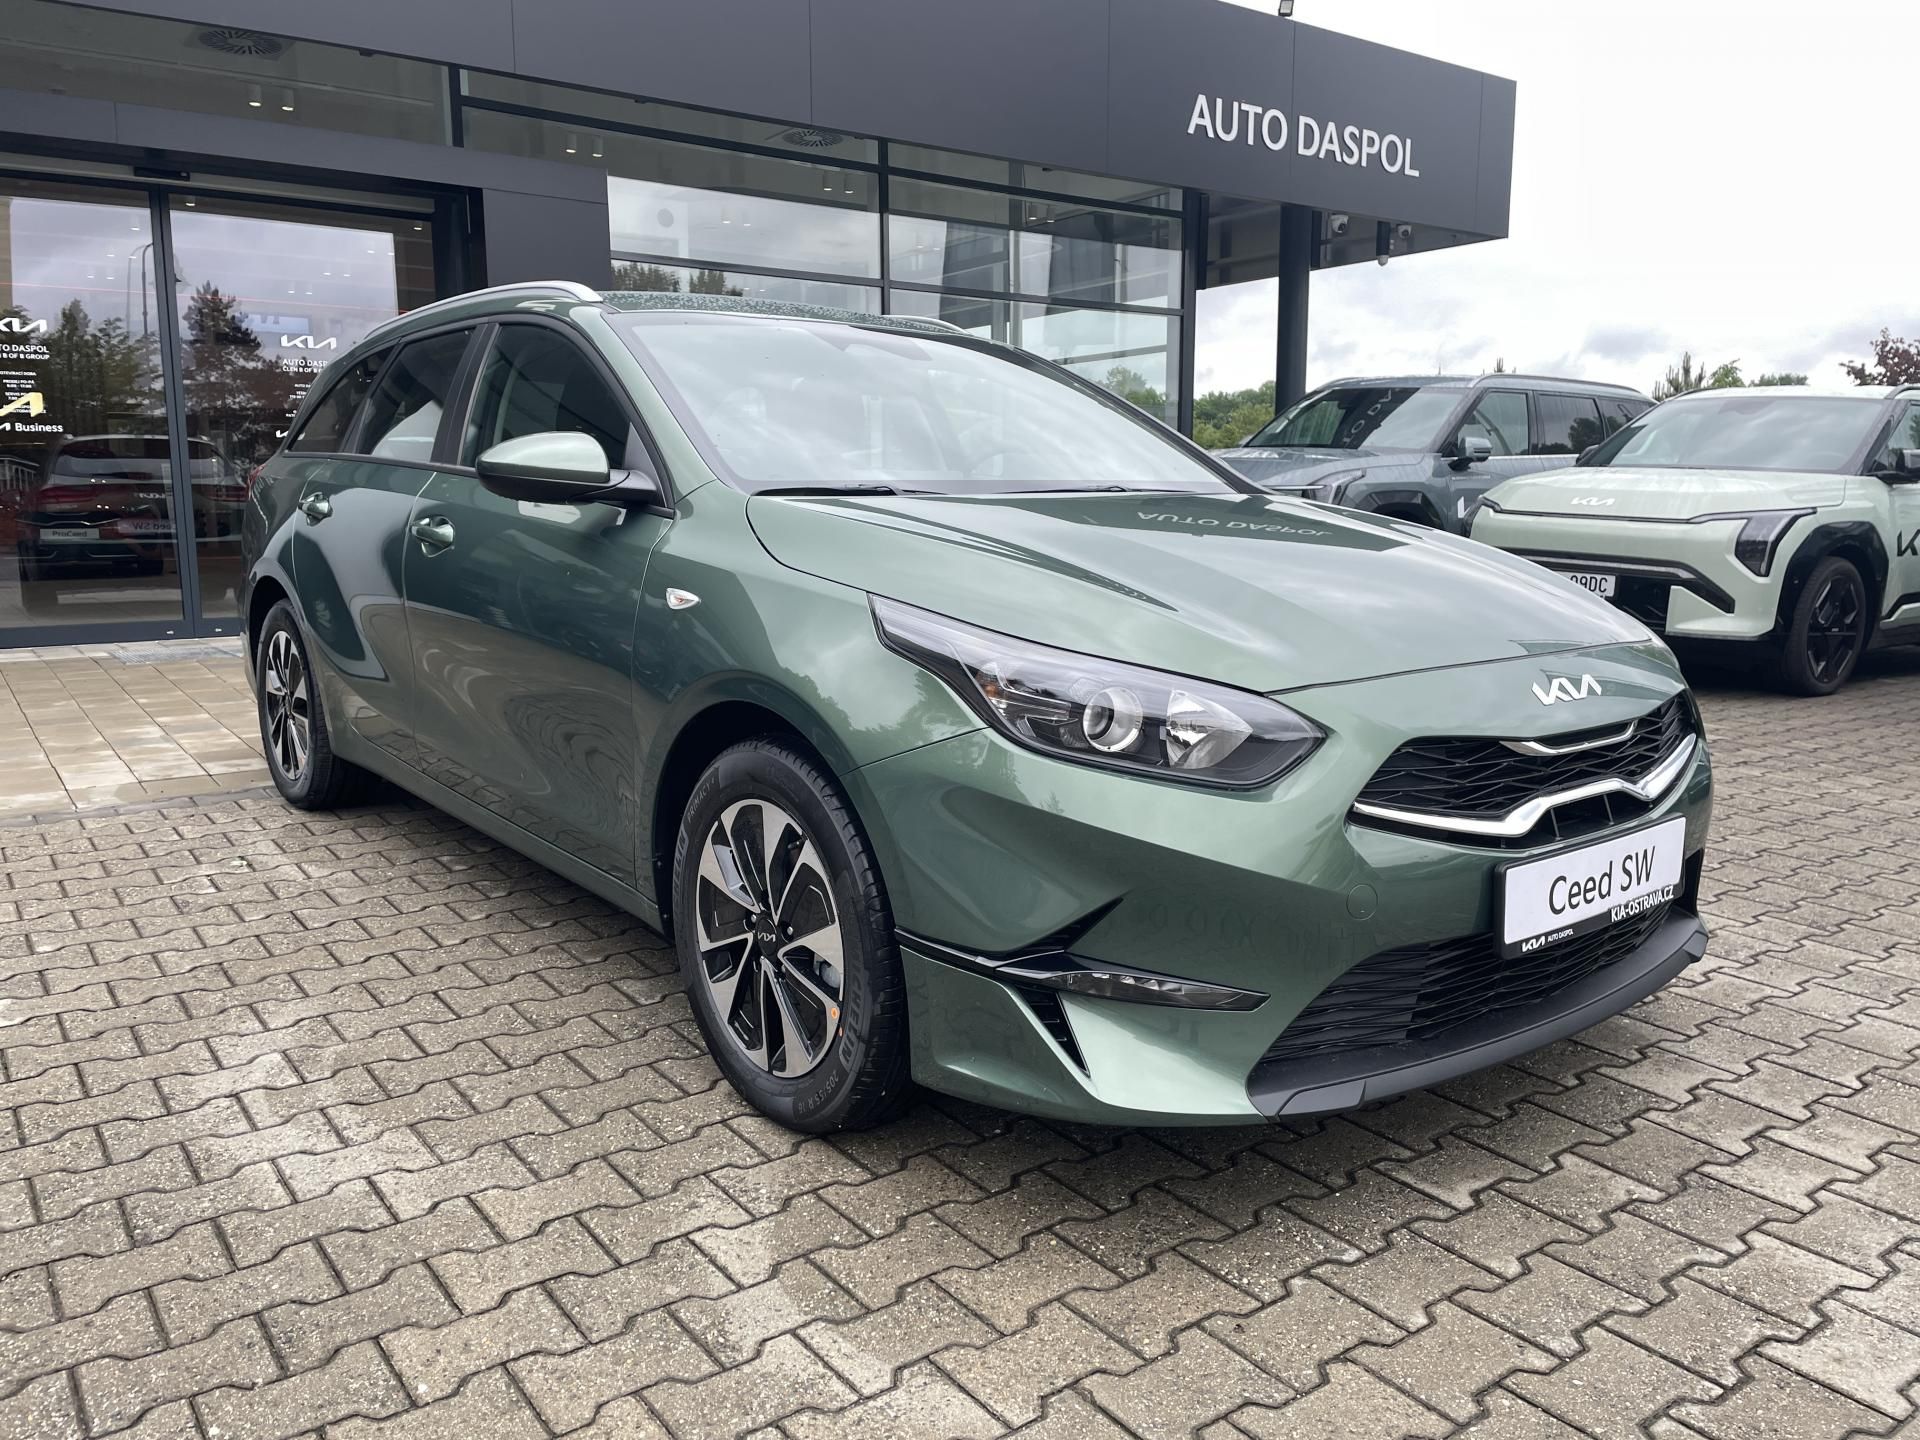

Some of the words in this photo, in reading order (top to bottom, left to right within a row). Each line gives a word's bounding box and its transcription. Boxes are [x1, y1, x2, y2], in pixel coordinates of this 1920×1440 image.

[1187, 94, 1288, 151] AUTO
[1298, 115, 1420, 177] DASPOL
[12, 344, 49, 353] DASPOL
[280, 334, 337, 350] KIA
[282, 359, 306, 367] AUTO
[15, 422, 63, 433] Business
[1571, 496, 1616, 506] KIA
[1530, 673, 1602, 706] KIA
[1549, 860, 1614, 915] Ceed
[1620, 845, 1656, 892] SW
[1611, 884, 1675, 923] KIA-OSTRAVA.CZ
[757, 930, 777, 944] KIA
[1521, 936, 1546, 952] KIA
[1547, 932, 1559, 943] AUTO
[1558, 928, 1574, 939] DASPOL
